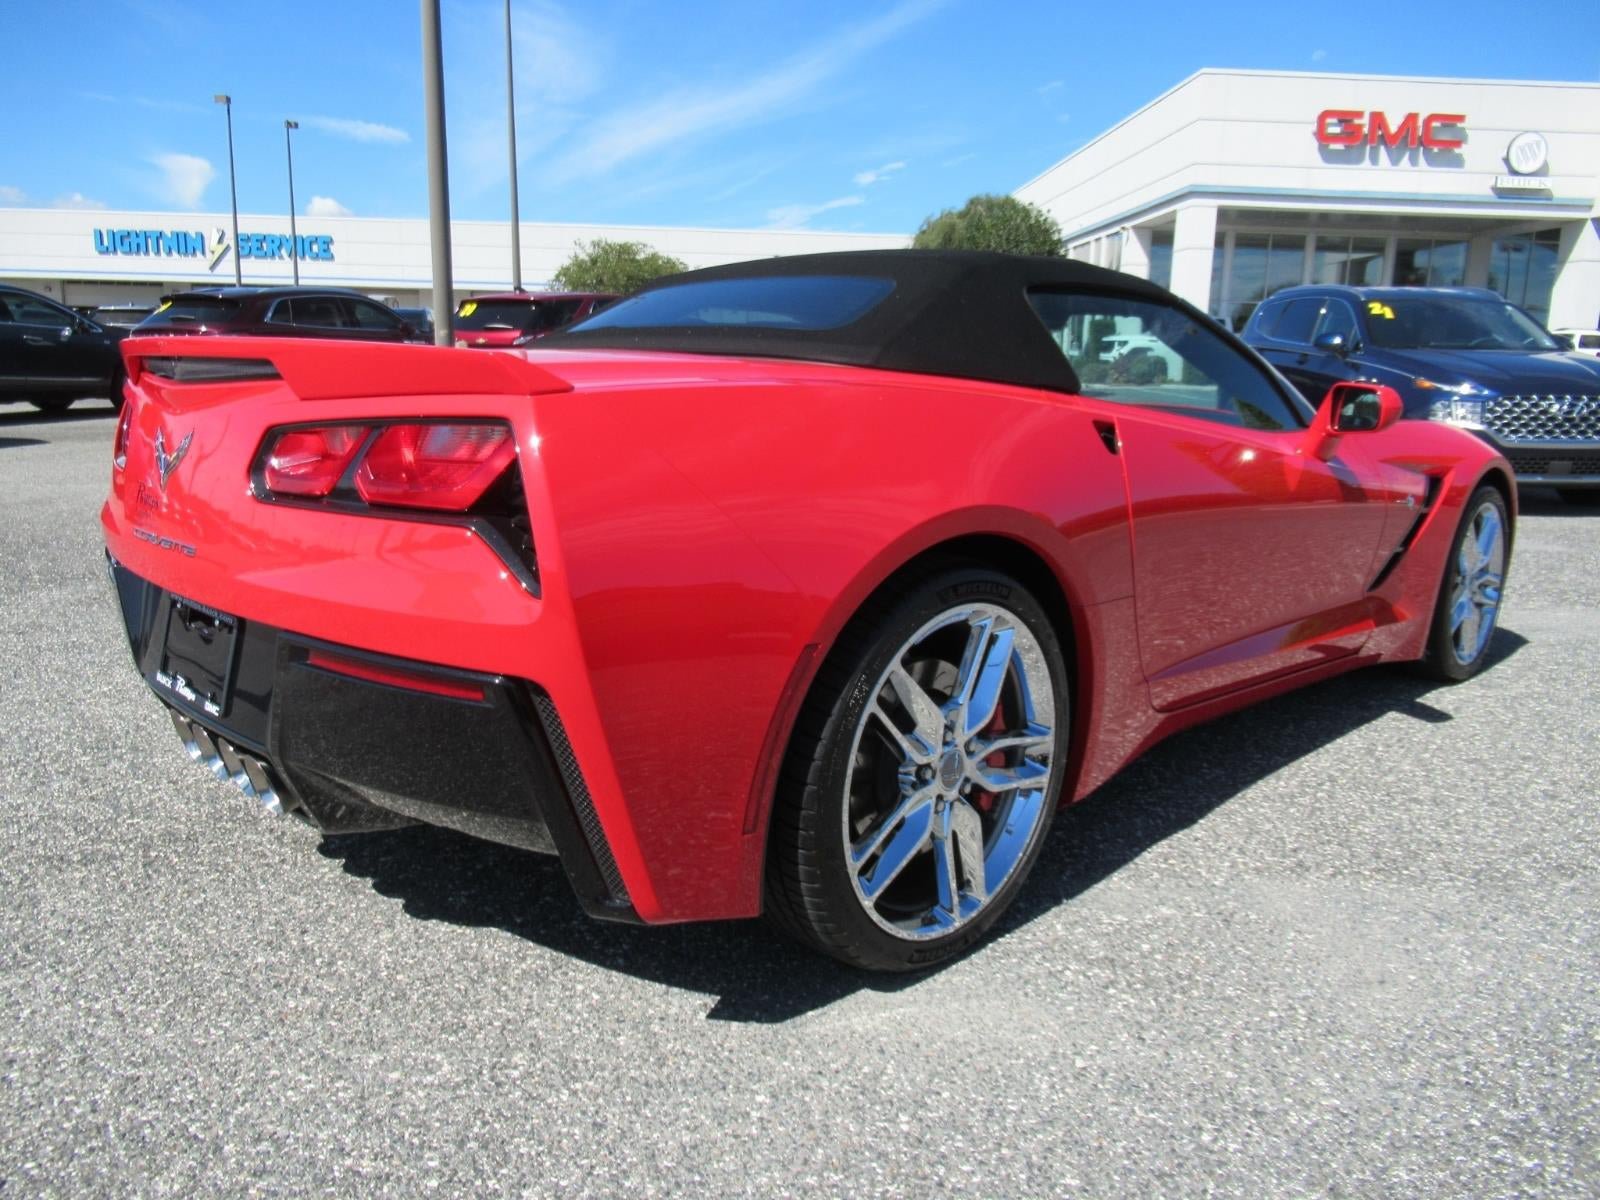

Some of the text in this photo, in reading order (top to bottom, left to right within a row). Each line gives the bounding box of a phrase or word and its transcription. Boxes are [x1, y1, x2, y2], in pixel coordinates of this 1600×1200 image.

[1316, 109, 1467, 148] GMC
[93, 228, 335, 261] LIGHTNIN SERVICE
